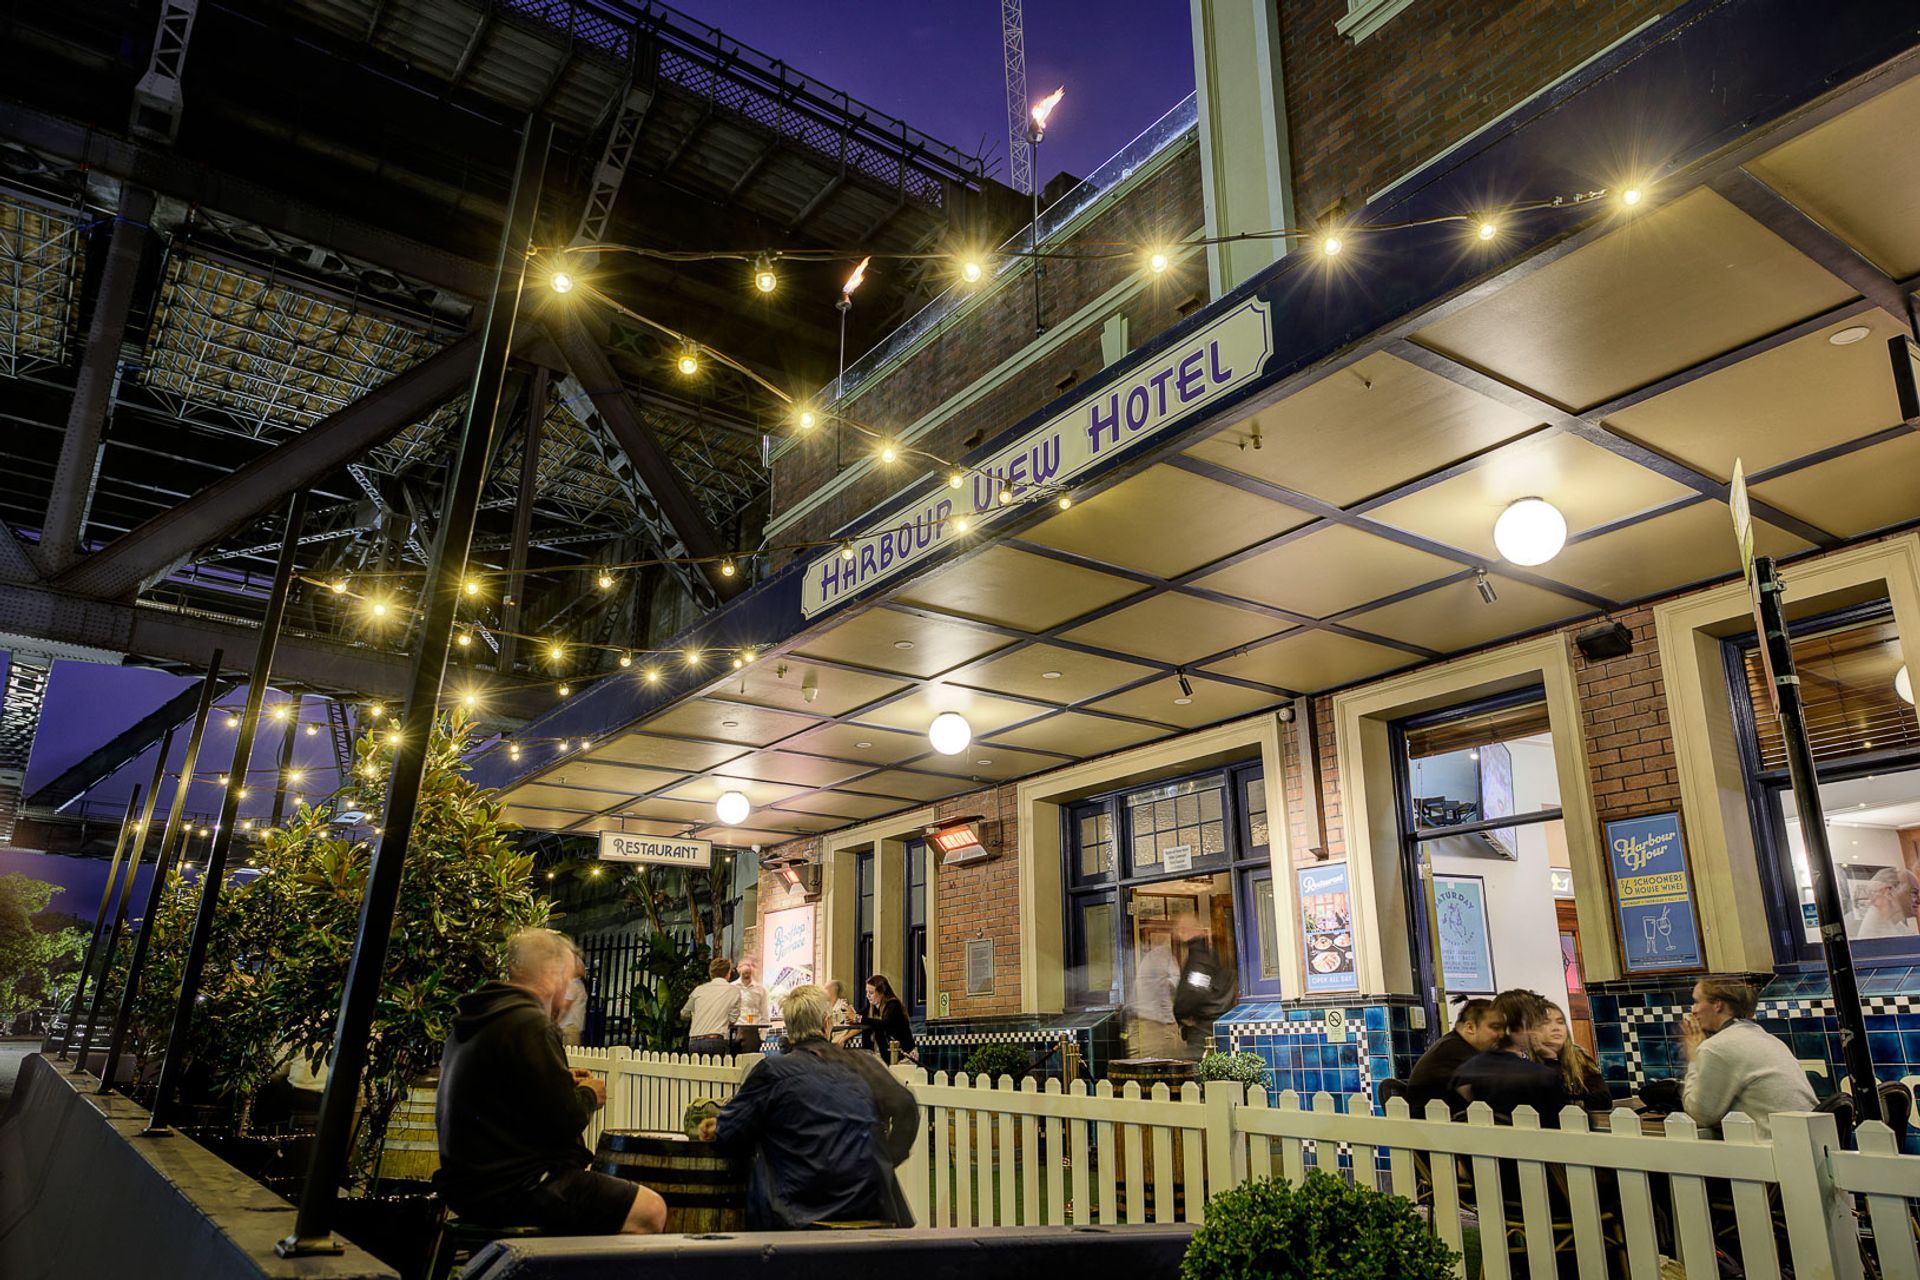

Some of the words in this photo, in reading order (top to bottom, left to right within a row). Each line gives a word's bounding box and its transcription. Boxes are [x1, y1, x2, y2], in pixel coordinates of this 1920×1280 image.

[821, 499, 953, 602] HARBOUR
[974, 434, 1061, 513] VIEW
[1088, 341, 1233, 454] HOTEL
[613, 838, 699, 859] RESTAURANT
[1614, 832, 1676, 857] Harbour
[1625, 845, 1668, 871] Hour
[1634, 874, 1683, 886] SCHOONERS
[1635, 885, 1659, 894] HOUSE
[1662, 882, 1684, 891] WINES
[1436, 891, 1475, 909] ATURDAY
